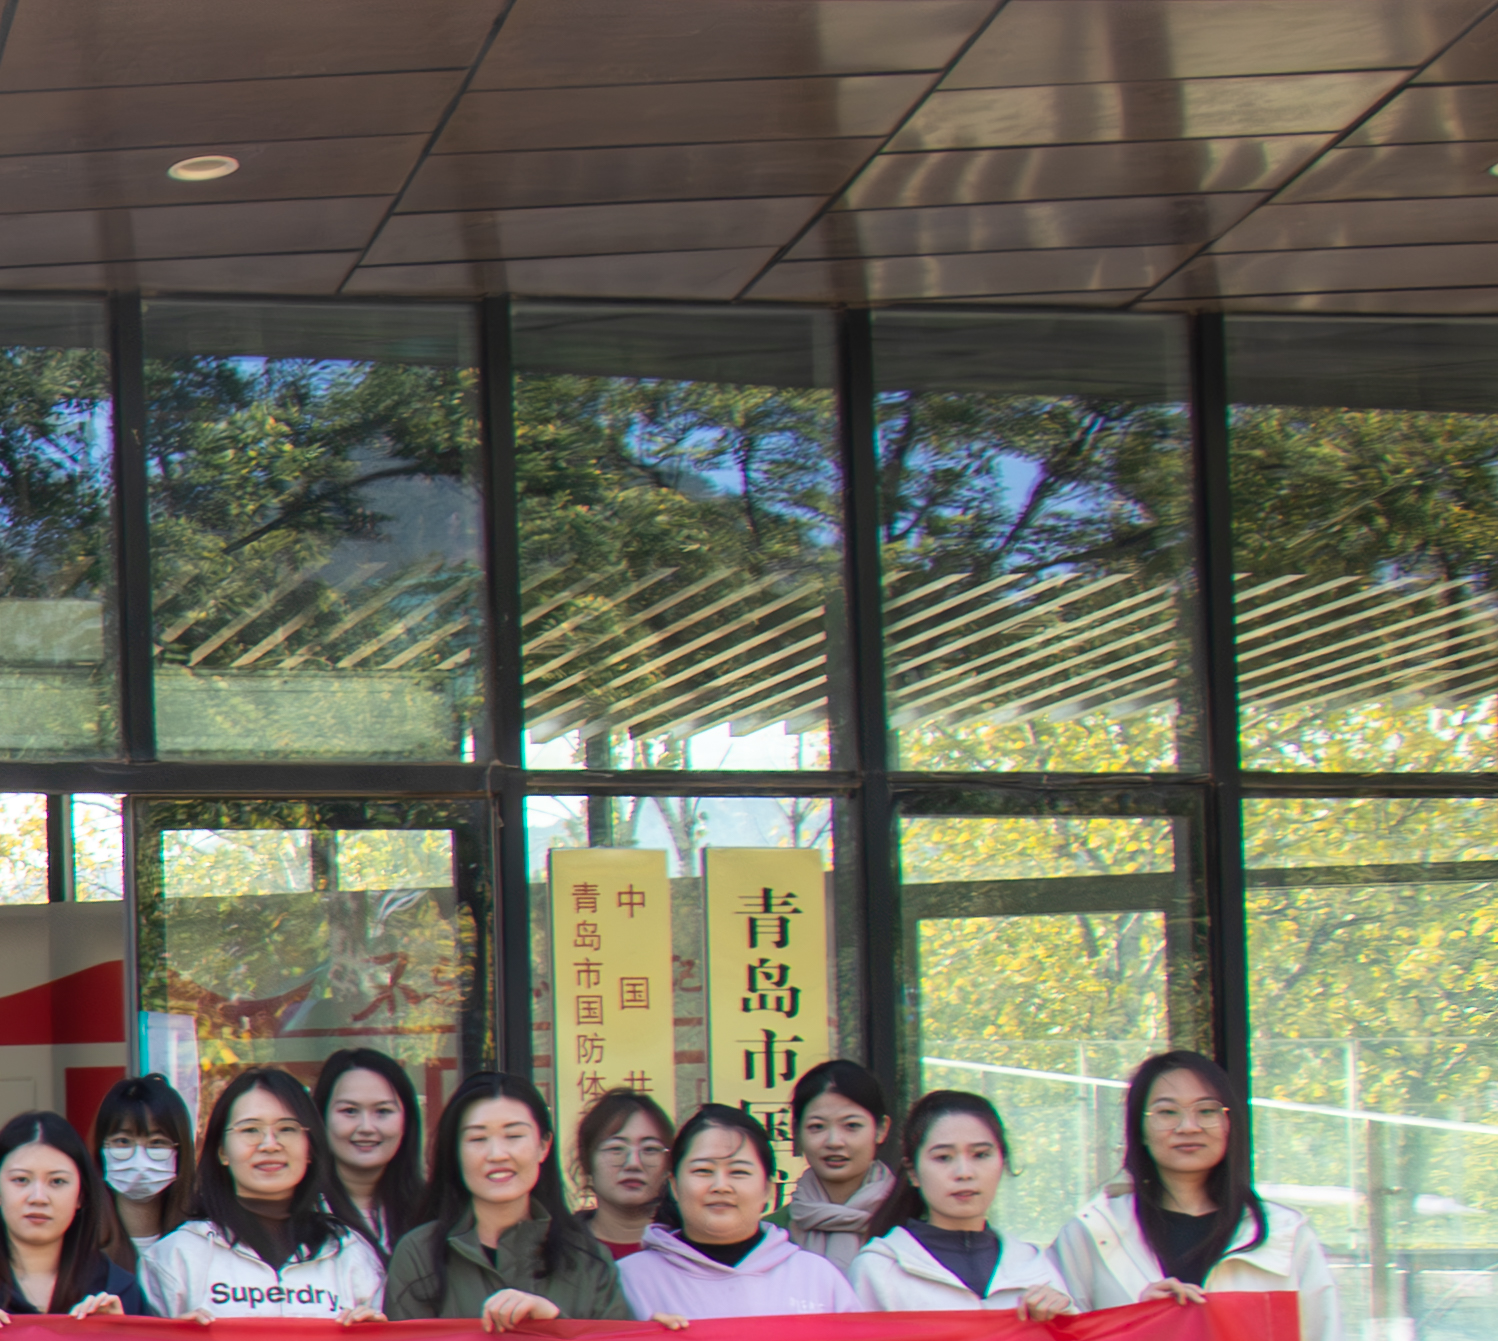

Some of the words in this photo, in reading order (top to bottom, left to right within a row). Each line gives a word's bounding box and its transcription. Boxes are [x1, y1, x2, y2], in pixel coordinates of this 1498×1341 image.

[572, 881, 606, 1115] 青岛市国防体
